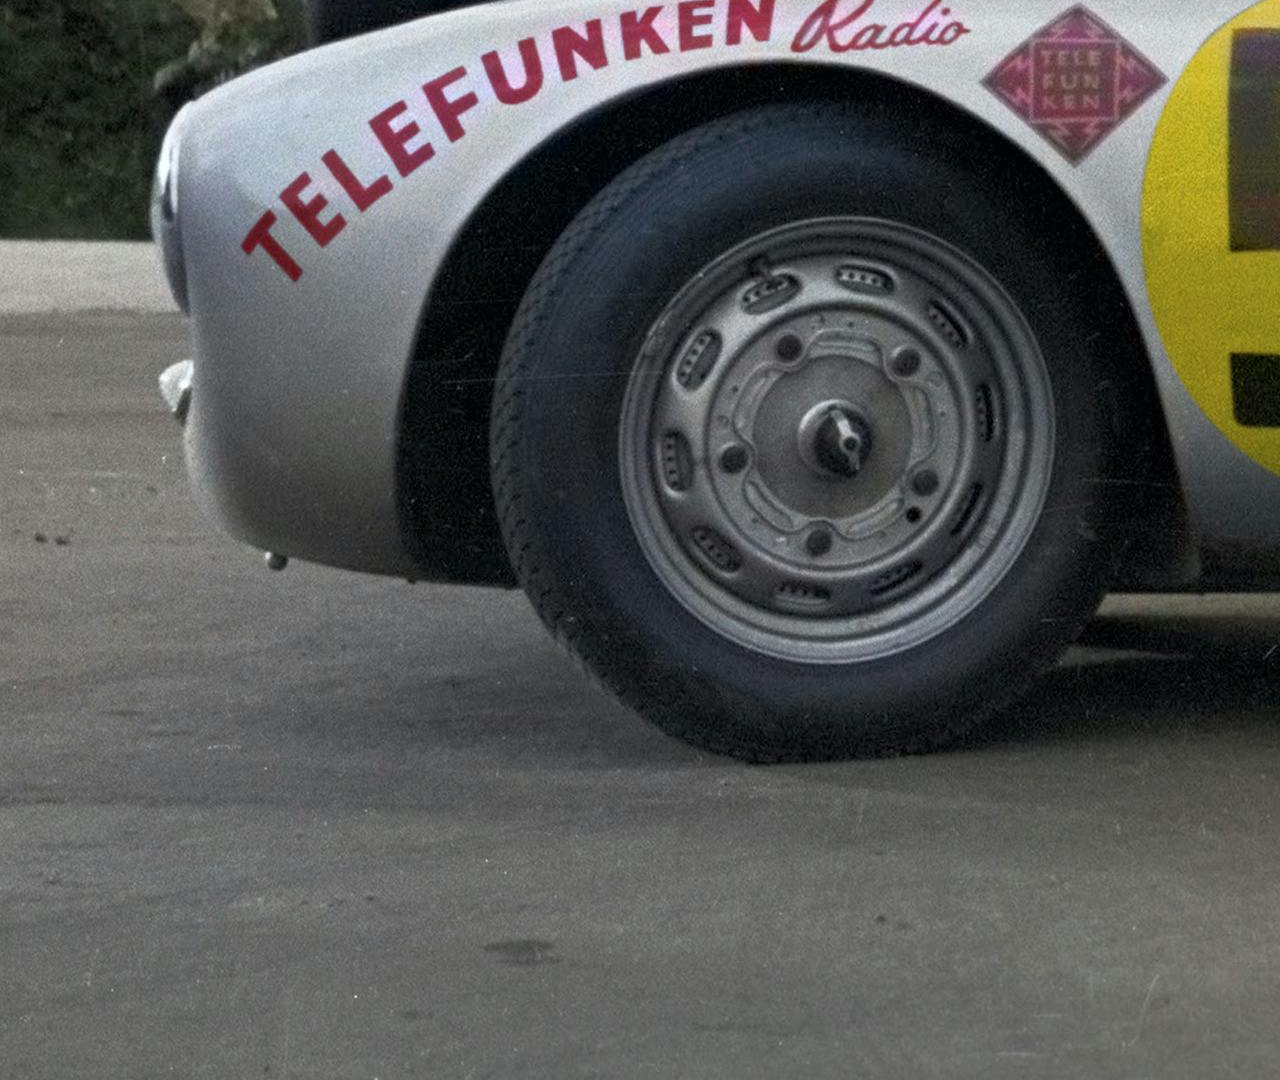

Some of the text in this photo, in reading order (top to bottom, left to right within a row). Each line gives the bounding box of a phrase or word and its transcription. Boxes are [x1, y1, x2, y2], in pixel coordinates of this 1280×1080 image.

[1040, 50, 1102, 66] TELE
[1042, 73, 1100, 90] FUN
[1042, 94, 1100, 110] KEN
